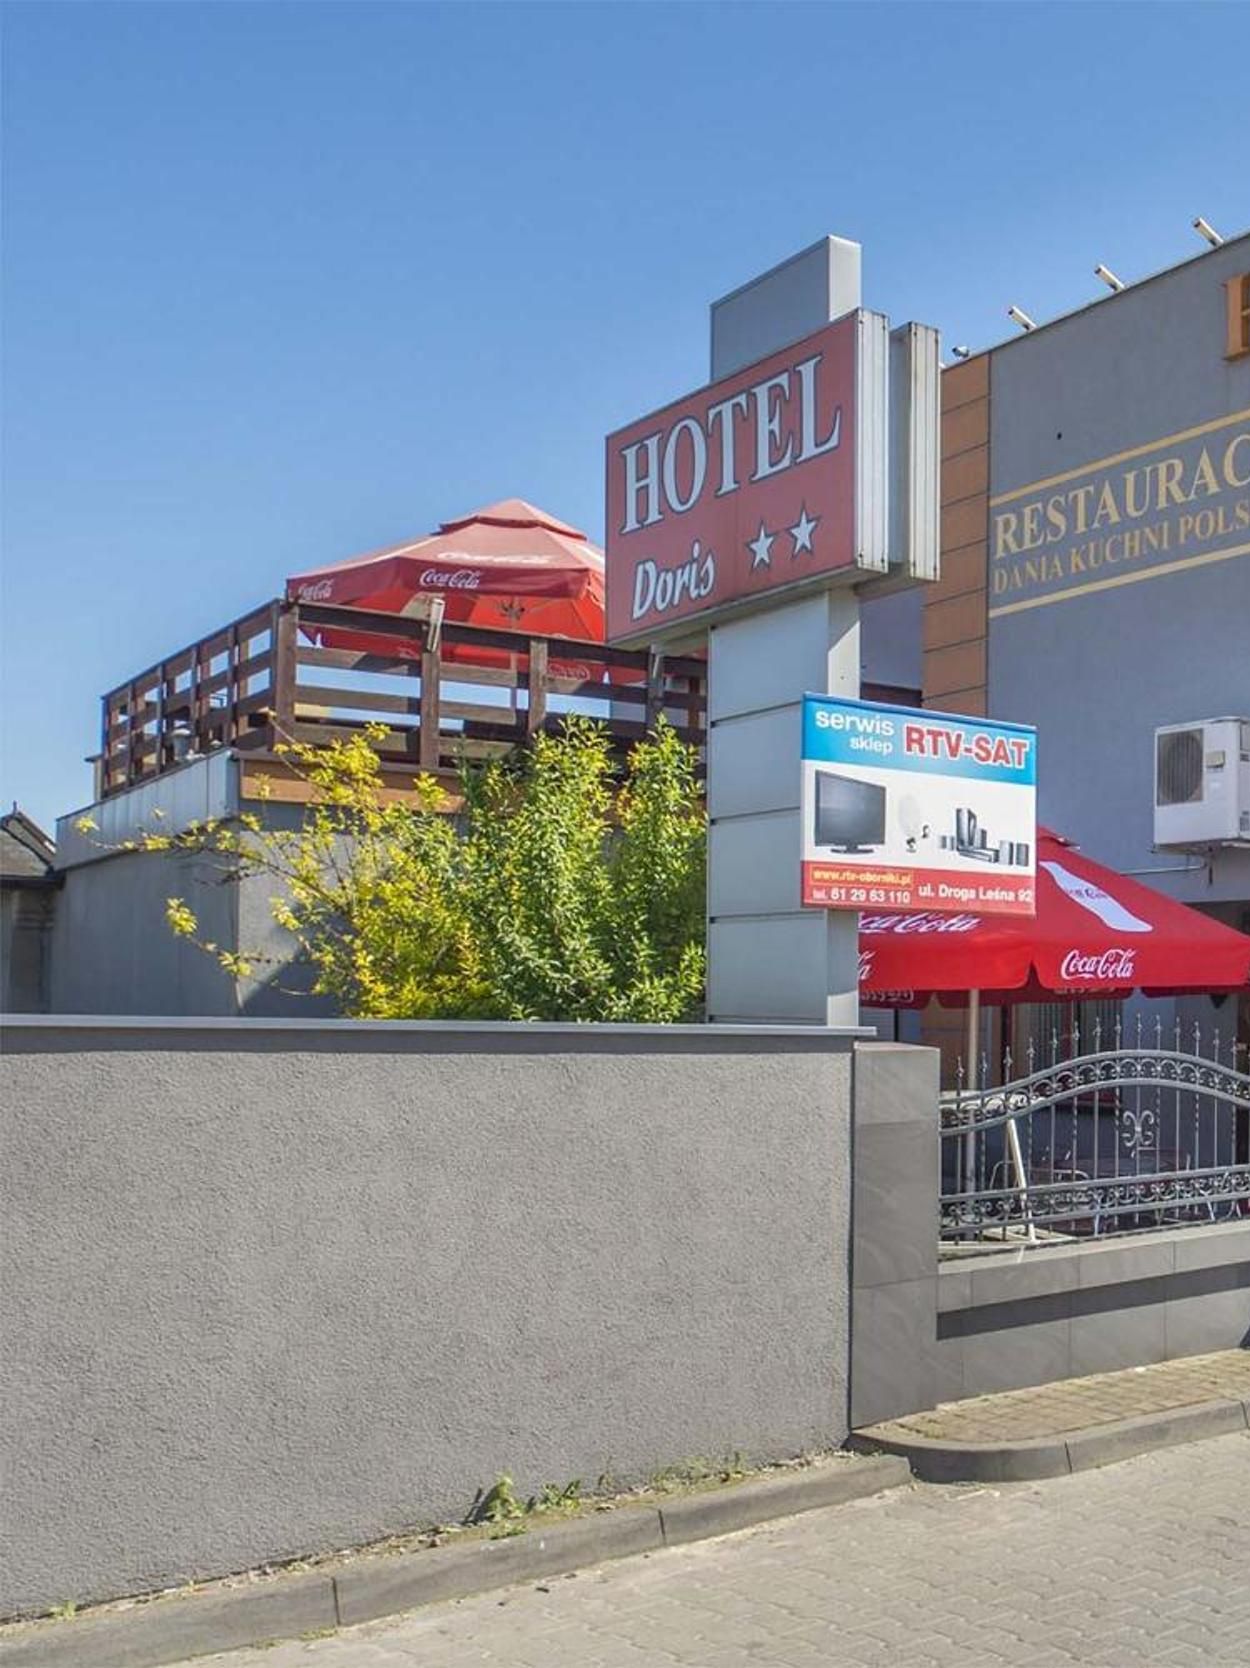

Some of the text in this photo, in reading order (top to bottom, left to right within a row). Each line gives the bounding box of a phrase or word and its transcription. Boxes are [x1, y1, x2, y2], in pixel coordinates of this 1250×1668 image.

[620, 355, 842, 535] HOTEL
[993, 554, 1064, 593] DANIA
[1071, 520, 1169, 574] KUCHNI
[632, 540, 716, 621] Doris
[815, 711, 895, 736] serwis
[850, 736, 893, 755] sklep
[905, 723, 1029, 768] RTV-SAT
[889, 891, 911, 904] 110
[918, 882, 935, 896] ul.
[938, 884, 976, 901] Droga
[1061, 948, 1136, 980] Coca-Cola
